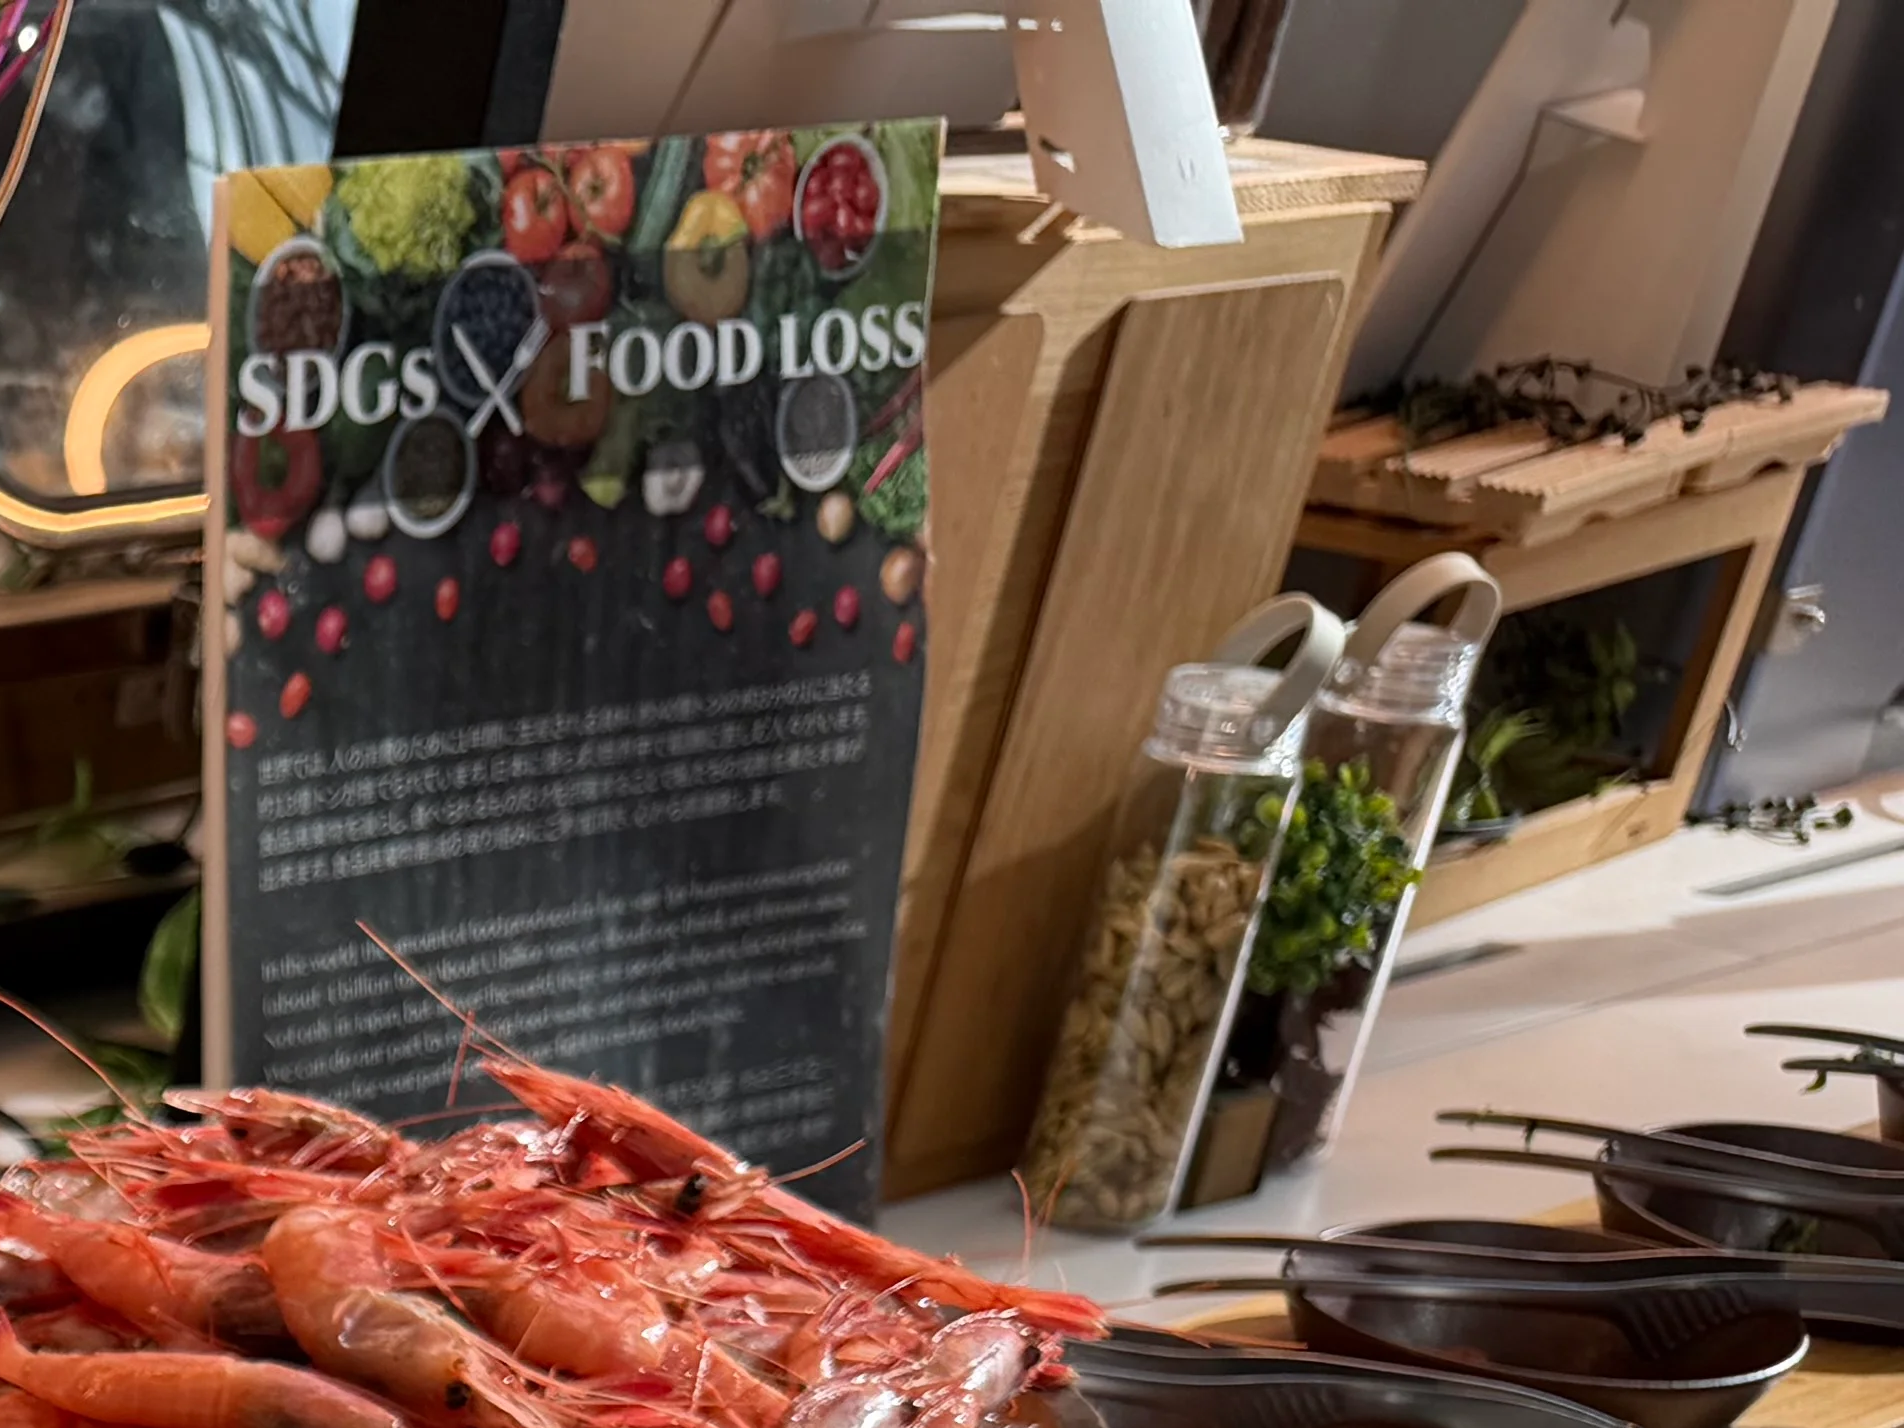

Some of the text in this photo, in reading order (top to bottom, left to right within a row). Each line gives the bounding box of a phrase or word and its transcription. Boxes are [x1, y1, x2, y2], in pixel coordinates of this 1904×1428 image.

[236, 303, 926, 438] SDGs FOOD LOSS
